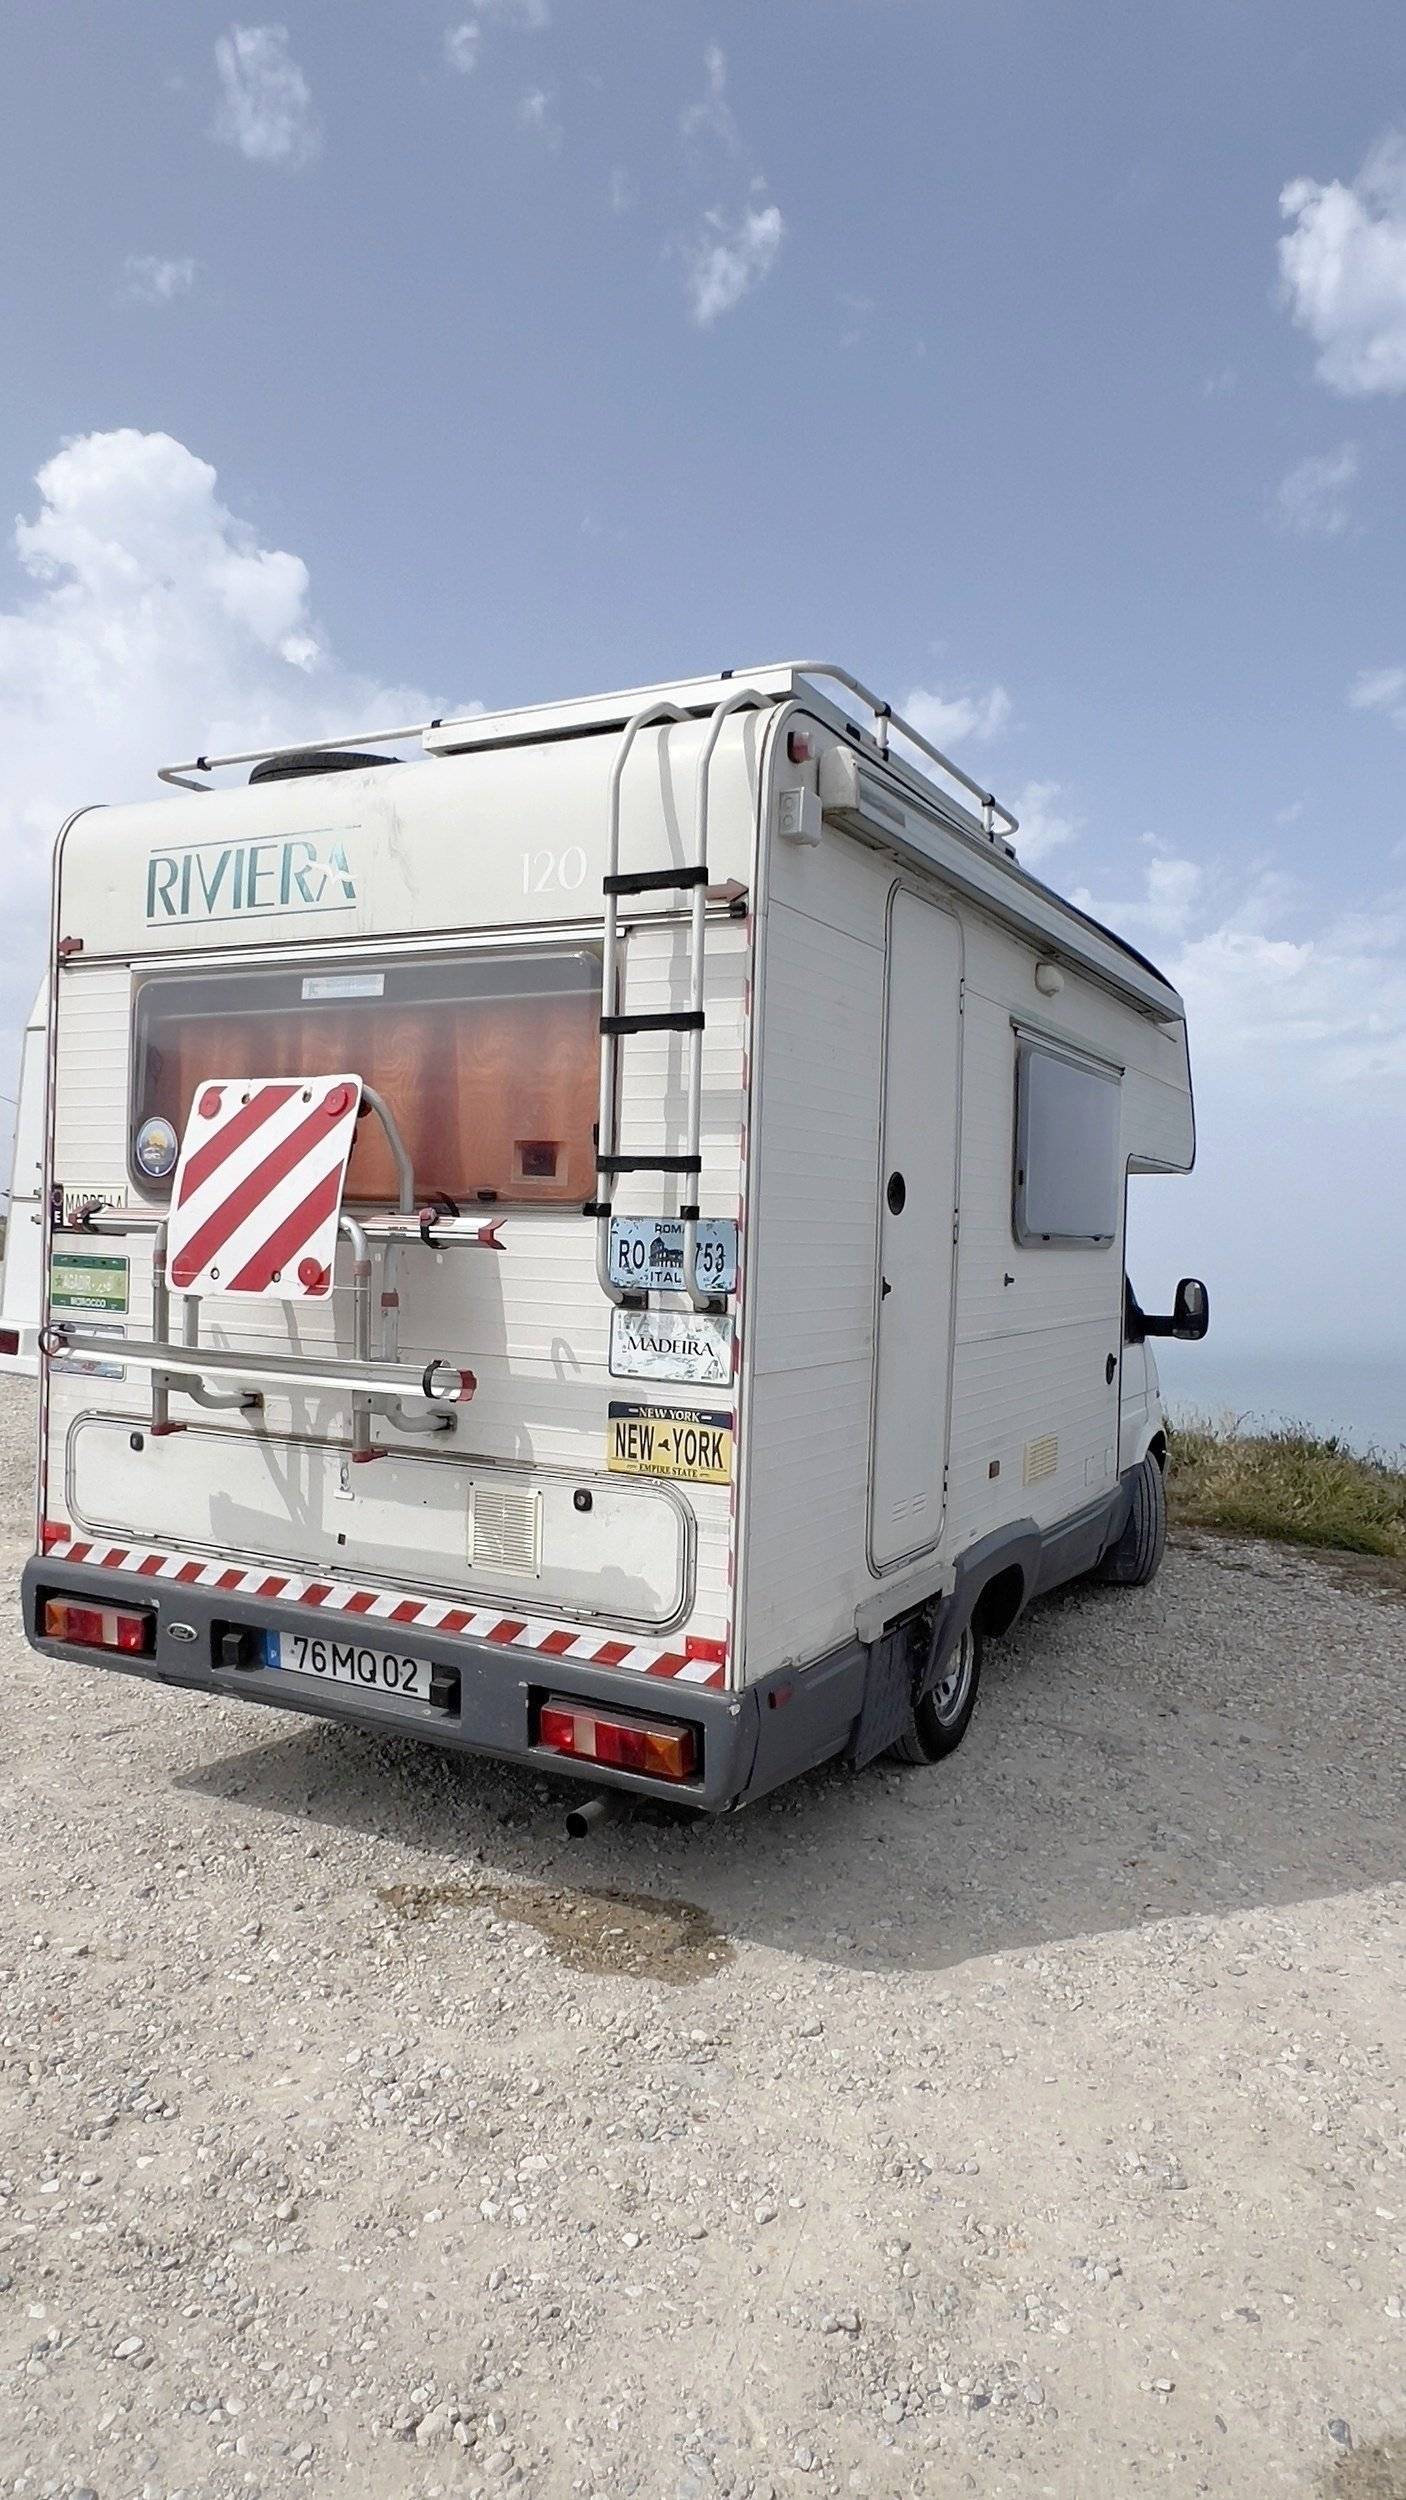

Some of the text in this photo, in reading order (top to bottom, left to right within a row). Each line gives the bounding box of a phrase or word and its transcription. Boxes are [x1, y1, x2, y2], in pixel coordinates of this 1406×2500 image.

[146, 841, 357, 918] RIVIERA
[521, 846, 588, 894] 120
[654, 1223, 685, 1234] ROM
[619, 1239, 645, 1269] RO
[650, 1271, 683, 1284] ITAL
[628, 1336, 715, 1357] MADEIRA
[639, 1406, 701, 1423] NEW YORK
[616, 1422, 724, 1469] NEW YORK
[639, 1463, 670, 1475] EMPIRE
[671, 1466, 699, 1478] STATE
